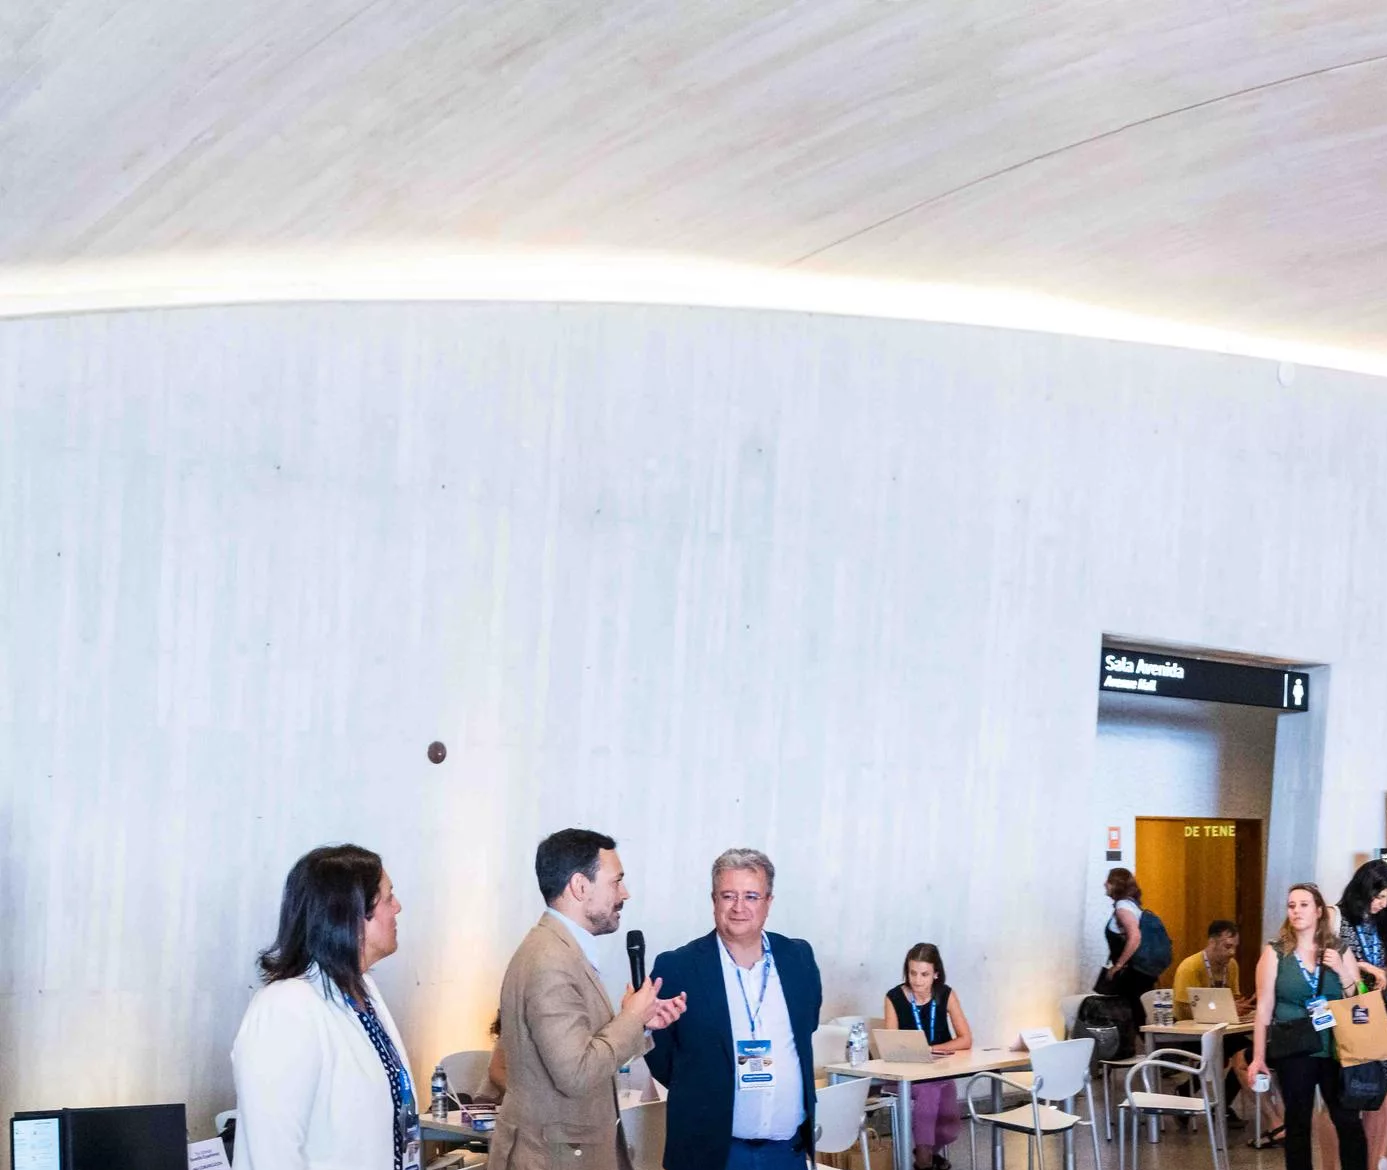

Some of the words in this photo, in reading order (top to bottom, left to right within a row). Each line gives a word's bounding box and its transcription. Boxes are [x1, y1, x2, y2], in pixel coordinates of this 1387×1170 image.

[1105, 655, 1135, 673] Sala
[1136, 658, 1184, 679] Avenida
[1184, 826, 1200, 837] DE
